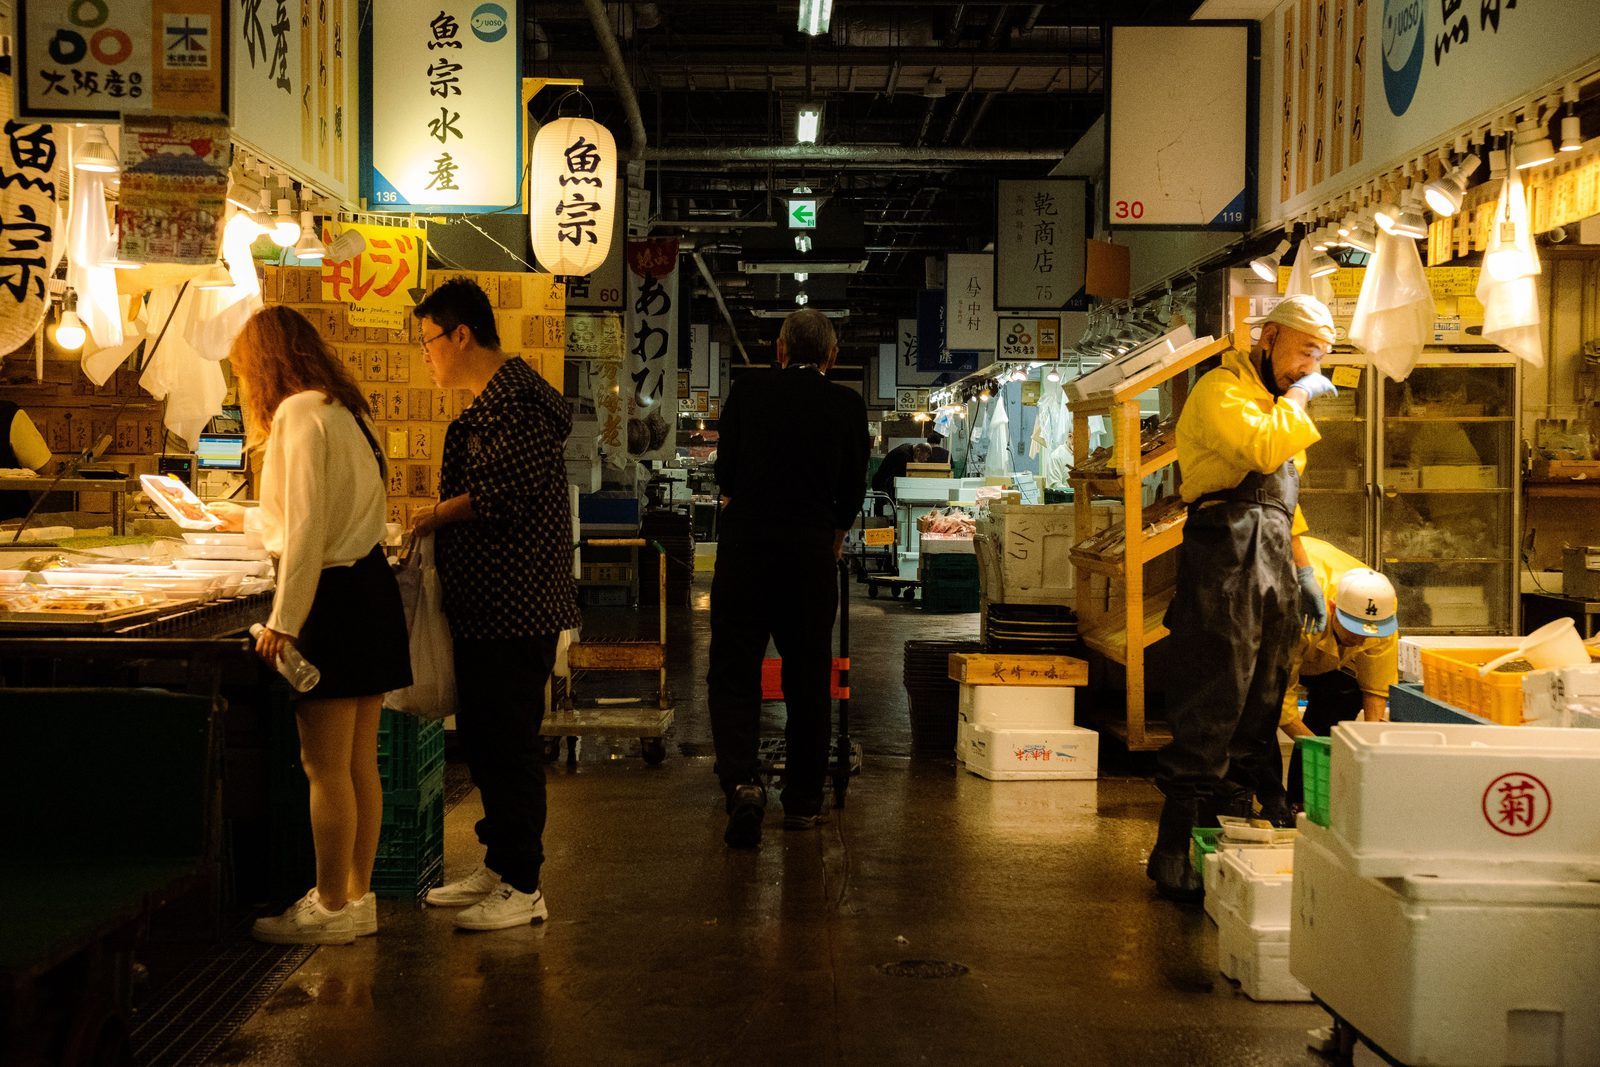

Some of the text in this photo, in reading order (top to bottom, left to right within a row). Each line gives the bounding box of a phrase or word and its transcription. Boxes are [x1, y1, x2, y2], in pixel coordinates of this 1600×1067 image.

[484, 19, 502, 27] UOSO
[424, 10, 464, 191] 魚宗水産
[375, 191, 398, 203] 136
[555, 136, 603, 247] 魚宗
[0, 122, 57, 303] 魚宗
[1115, 200, 1144, 220] 30
[1222, 211, 1243, 223] 119
[1032, 191, 1058, 274] 乾商店
[600, 288, 619, 302] 60
[1036, 286, 1052, 300] 75
[1365, 598, 1377, 615] LA
[991, 661, 1058, 683] 長崎の味
[1498, 780, 1536, 827] 菊
